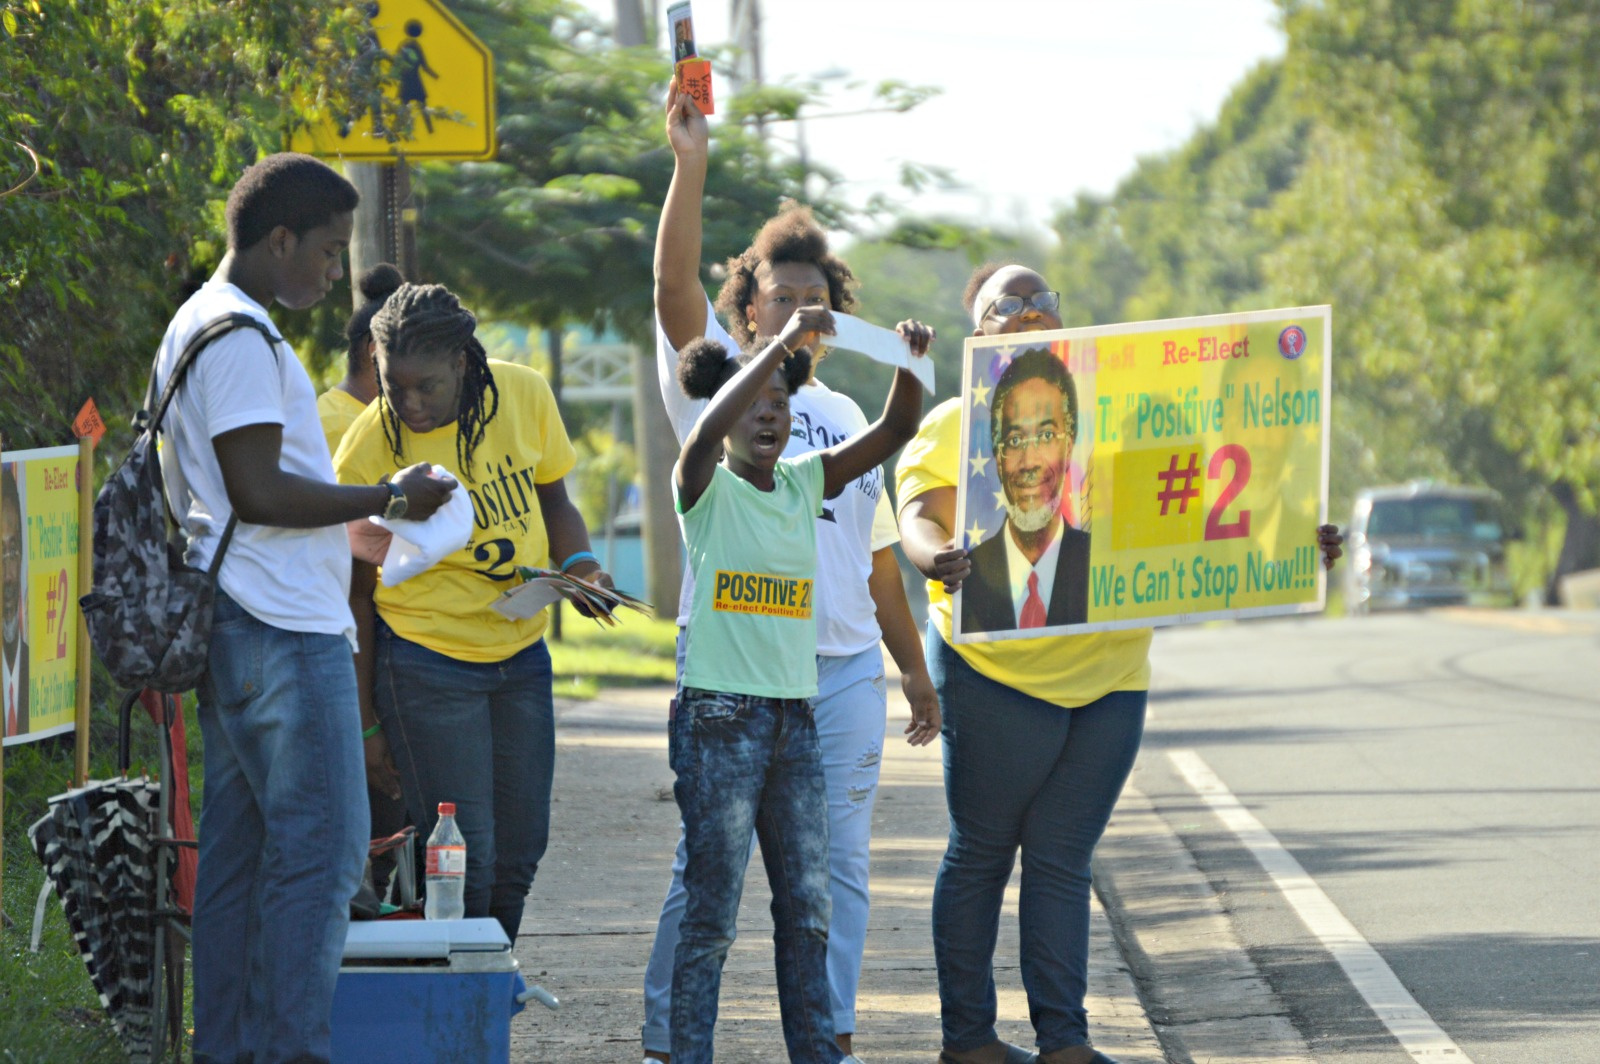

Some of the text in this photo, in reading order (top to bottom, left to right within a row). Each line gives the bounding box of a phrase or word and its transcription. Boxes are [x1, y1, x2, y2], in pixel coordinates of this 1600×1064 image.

[1162, 335, 1250, 366] Re-Elect
[1097, 395, 1117, 443] T.
[1243, 377, 1320, 430] Nelson
[467, 454, 534, 530] ositiv
[1157, 443, 1252, 541] #2
[716, 573, 798, 607] POSITIVE
[1092, 545, 1316, 608] We Can't Stop Now!!!
[715, 601, 759, 612] Re-elect
[762, 605, 794, 616] Positive
